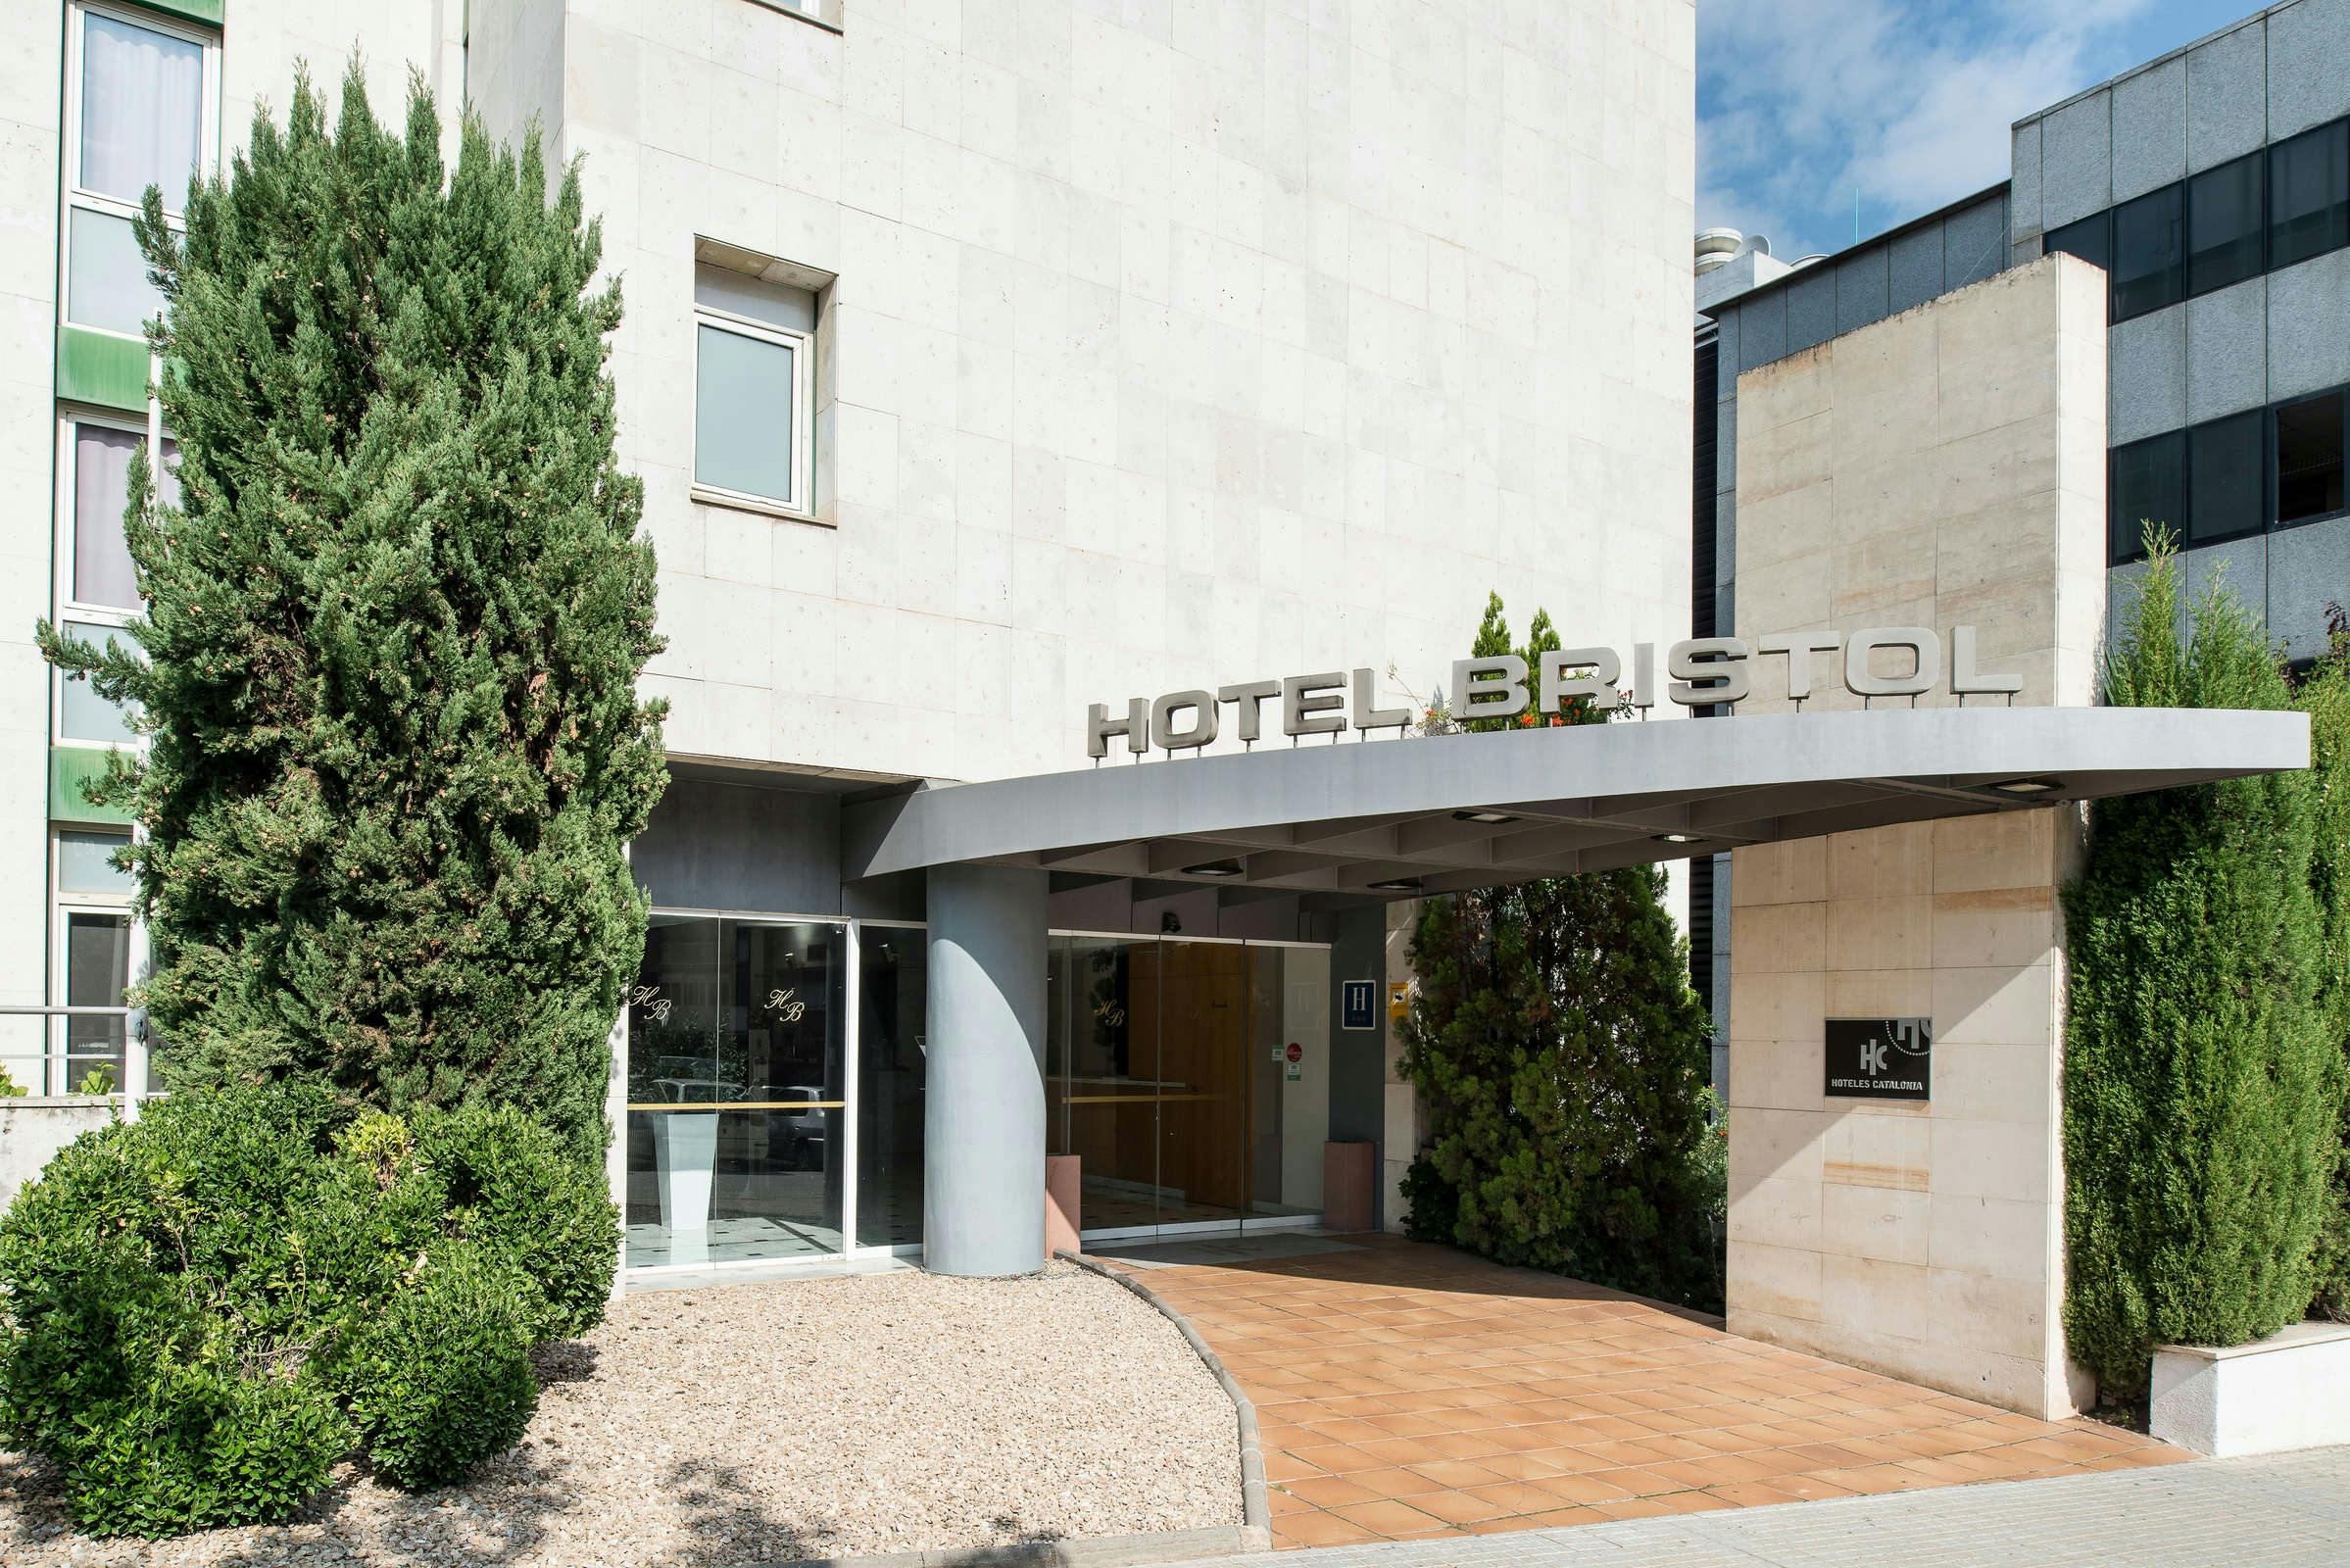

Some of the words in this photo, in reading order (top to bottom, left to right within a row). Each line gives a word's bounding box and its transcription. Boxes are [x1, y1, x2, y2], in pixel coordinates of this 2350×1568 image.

[1088, 667, 1413, 758] HOTEL
[1451, 625, 2024, 719] BRISTOL
[1352, 987, 1367, 1011] H
[1860, 1039, 1888, 1075] HC
[1831, 1078, 1871, 1089] HOTELES
[1872, 1080, 1923, 1091] CATALONIA
